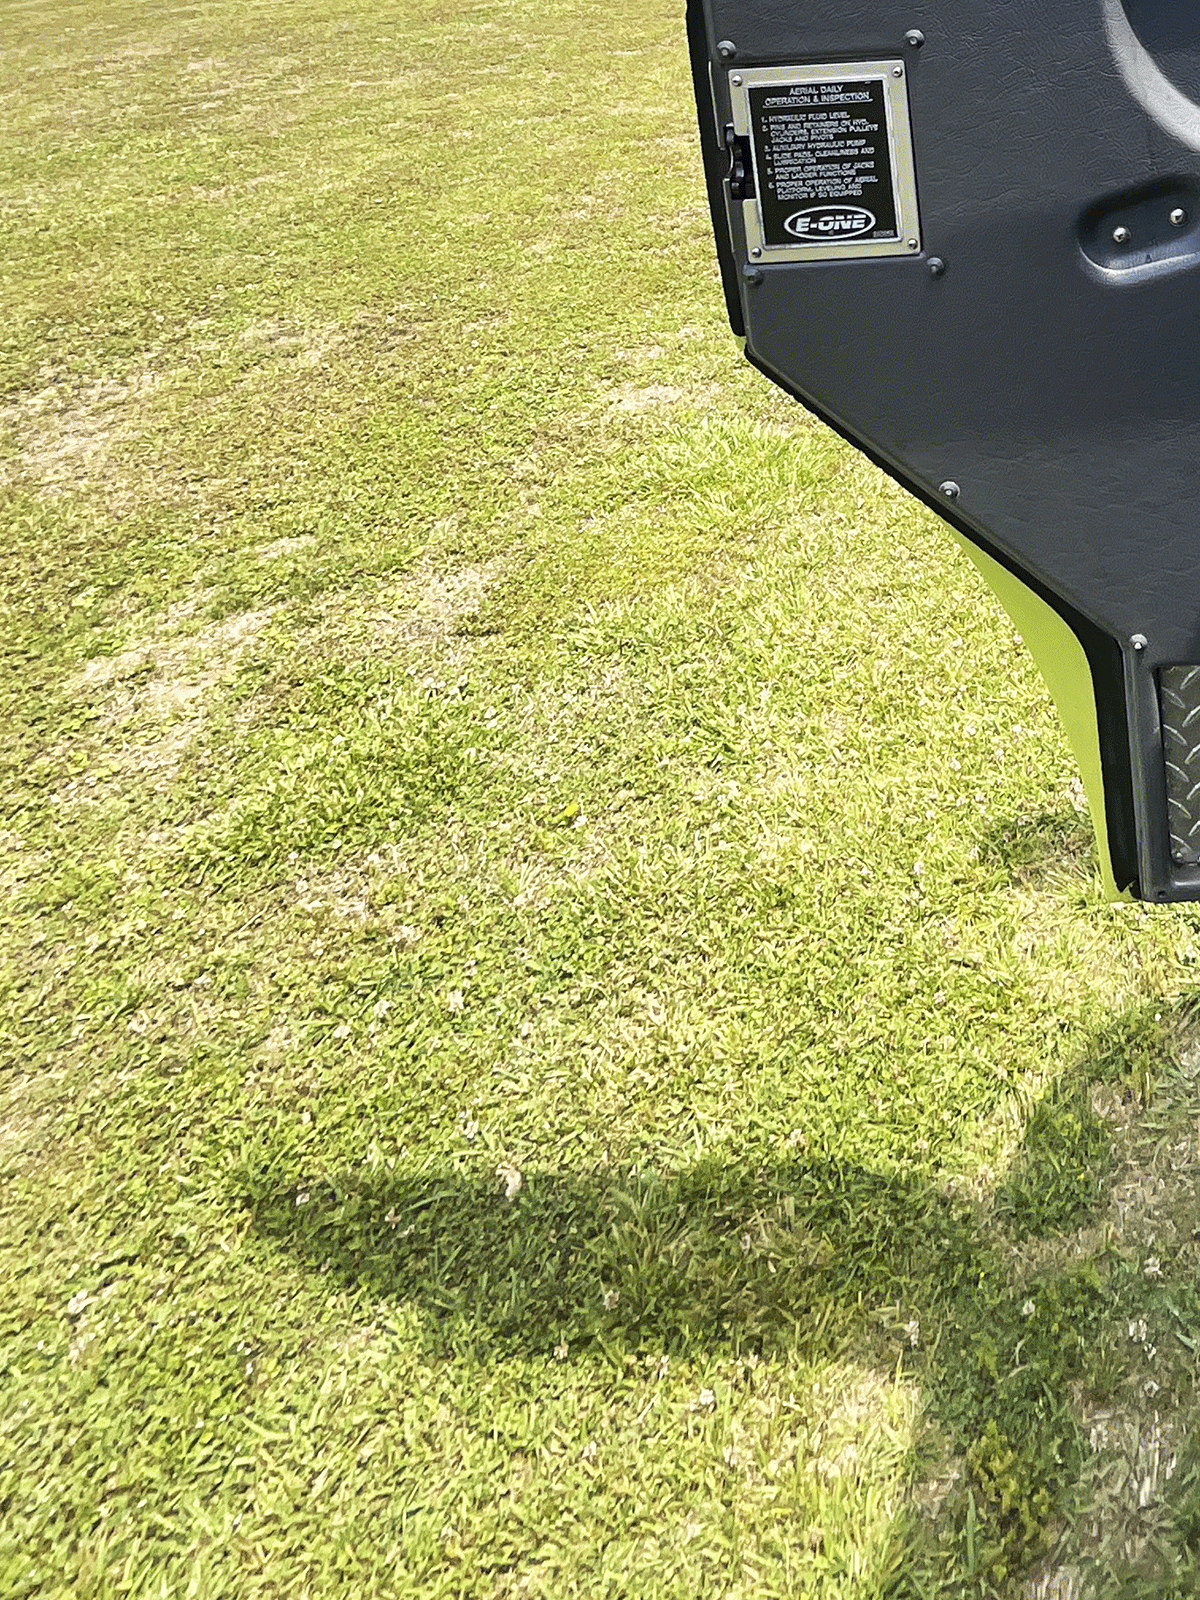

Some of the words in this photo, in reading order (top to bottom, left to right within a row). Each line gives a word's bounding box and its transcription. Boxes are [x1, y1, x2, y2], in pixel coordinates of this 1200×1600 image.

[790, 87, 818, 95] AERIAL
[820, 85, 843, 93] DAILY
[765, 96, 810, 106] OPERATION
[821, 92, 870, 102] INSPECTION
[769, 114, 806, 123] HYDRAULIC
[811, 126, 847, 135] EXTENSION
[807, 141, 845, 149] HYDRAULIC
[846, 139, 866, 147] PUMP
[815, 148, 859, 157] CLEANLINESS
[774, 157, 816, 166] LUBRICATION
[819, 169, 856, 177] FUNCTIONS
[805, 178, 841, 186] OPERATION
[815, 184, 845, 192] LEVELING
[796, 214, 866, 232] E-ONE
